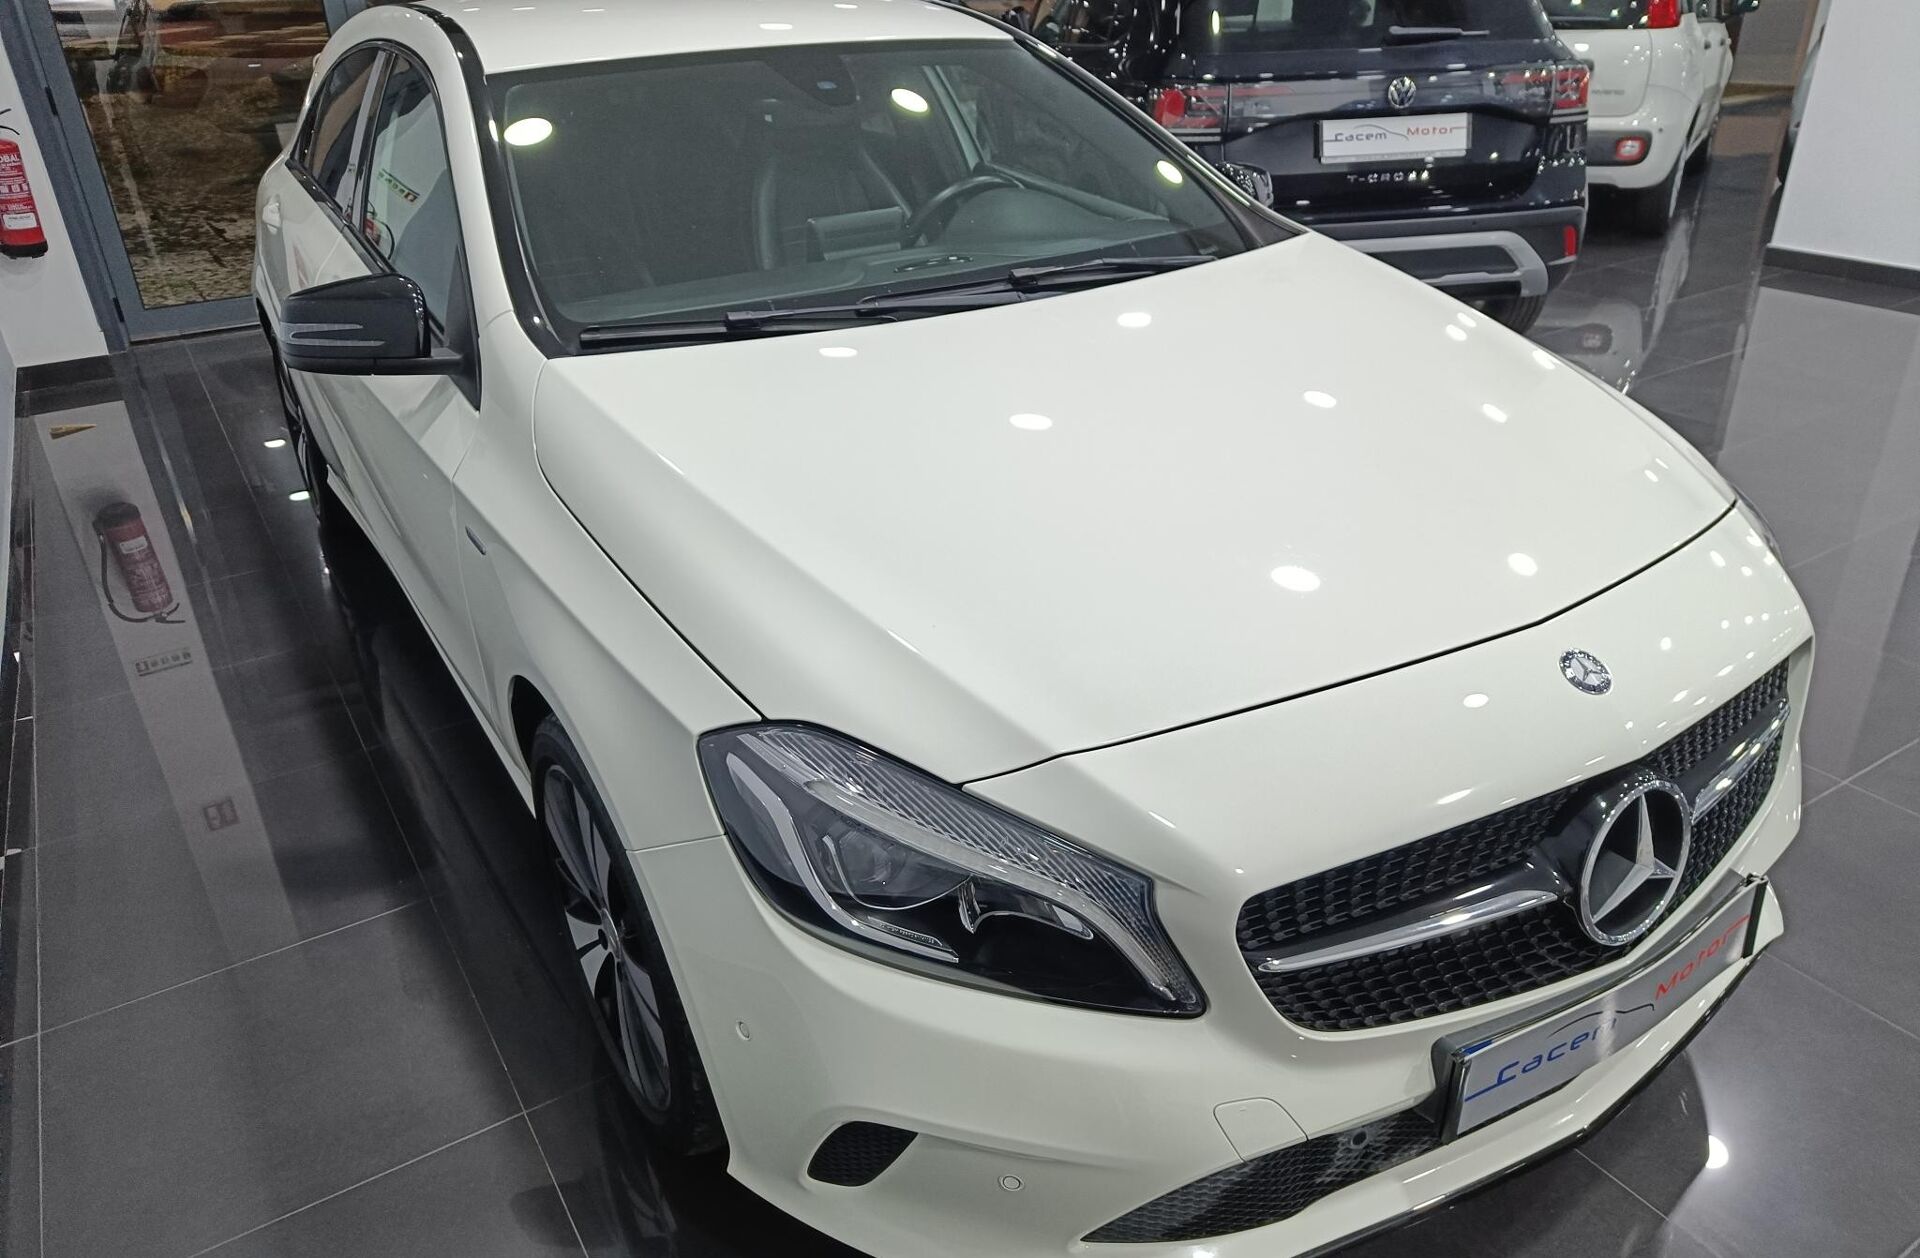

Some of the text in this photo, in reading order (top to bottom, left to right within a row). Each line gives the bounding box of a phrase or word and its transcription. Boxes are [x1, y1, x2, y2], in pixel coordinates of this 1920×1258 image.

[1324, 126, 1467, 142] Cacem Motor
[1655, 914, 1750, 1001] Motor
